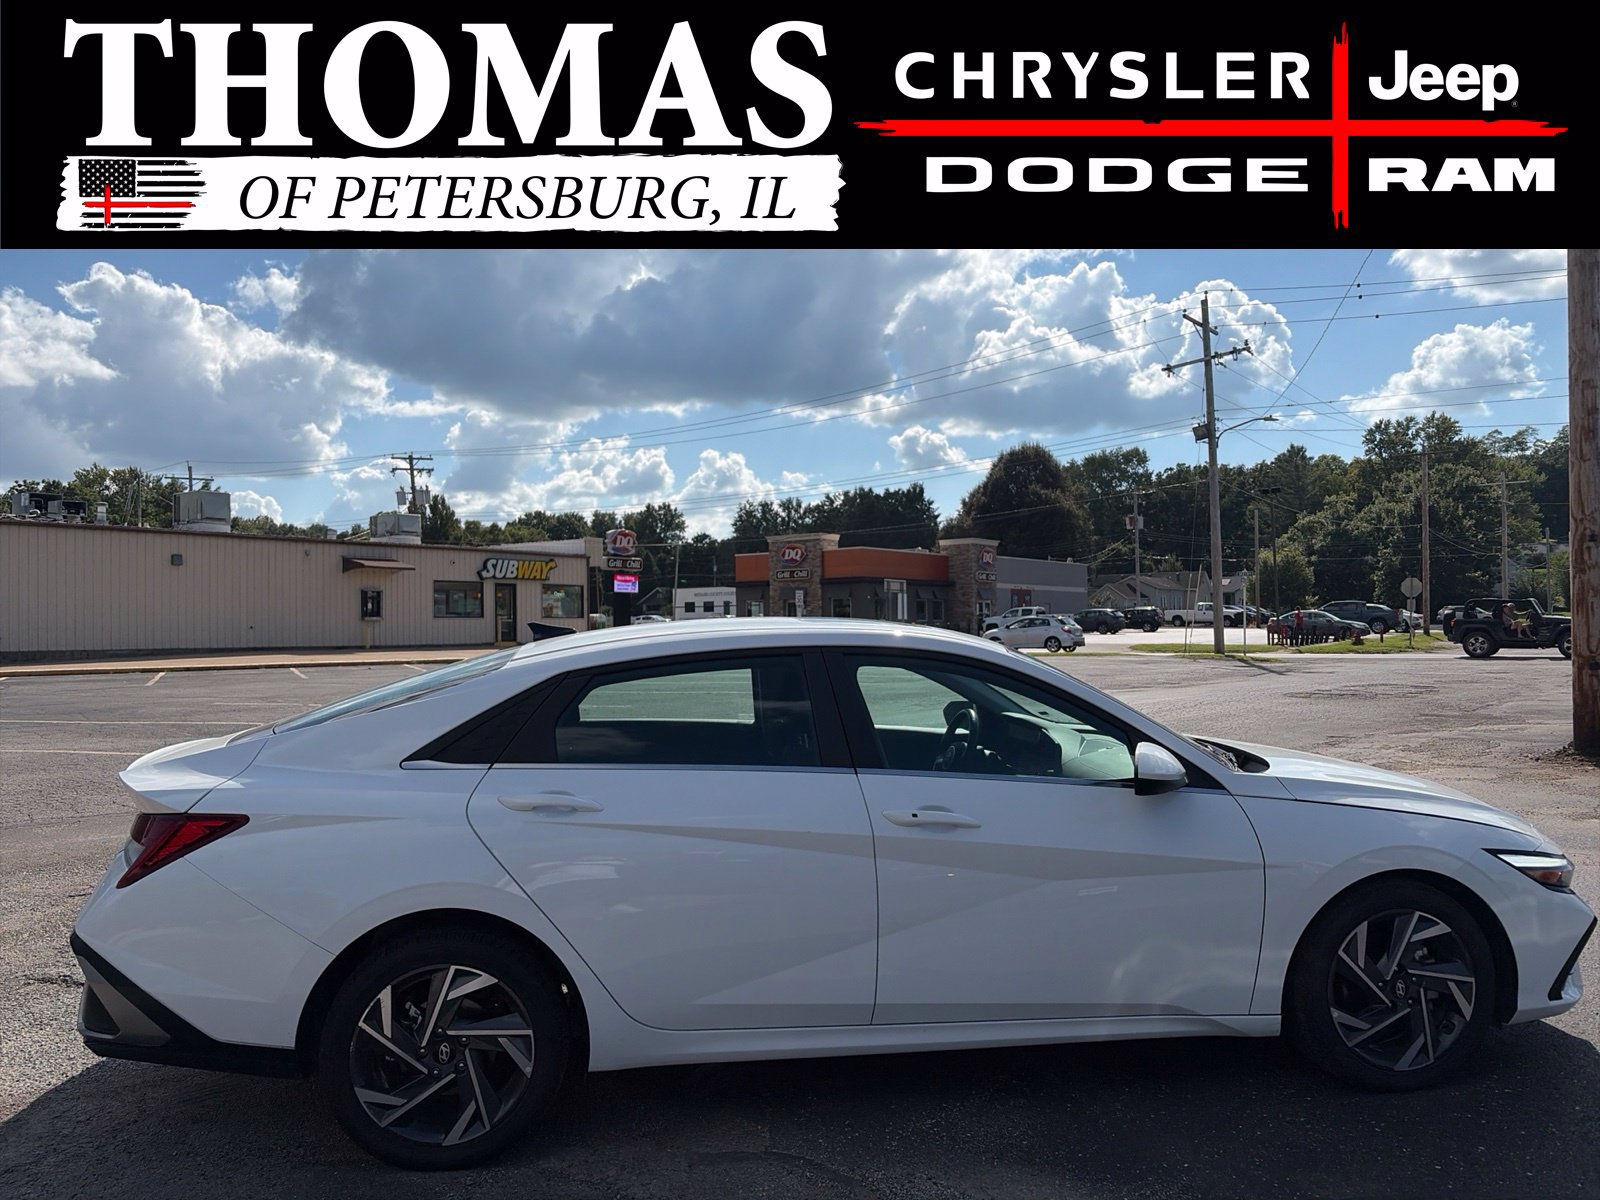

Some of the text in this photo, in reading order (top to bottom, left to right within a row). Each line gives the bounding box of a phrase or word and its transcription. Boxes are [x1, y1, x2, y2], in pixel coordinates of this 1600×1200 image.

[616, 535, 633, 550] DQ
[784, 549, 801, 560] DQ
[983, 552, 993, 564] DQ
[480, 558, 557, 580] SUBWAY
